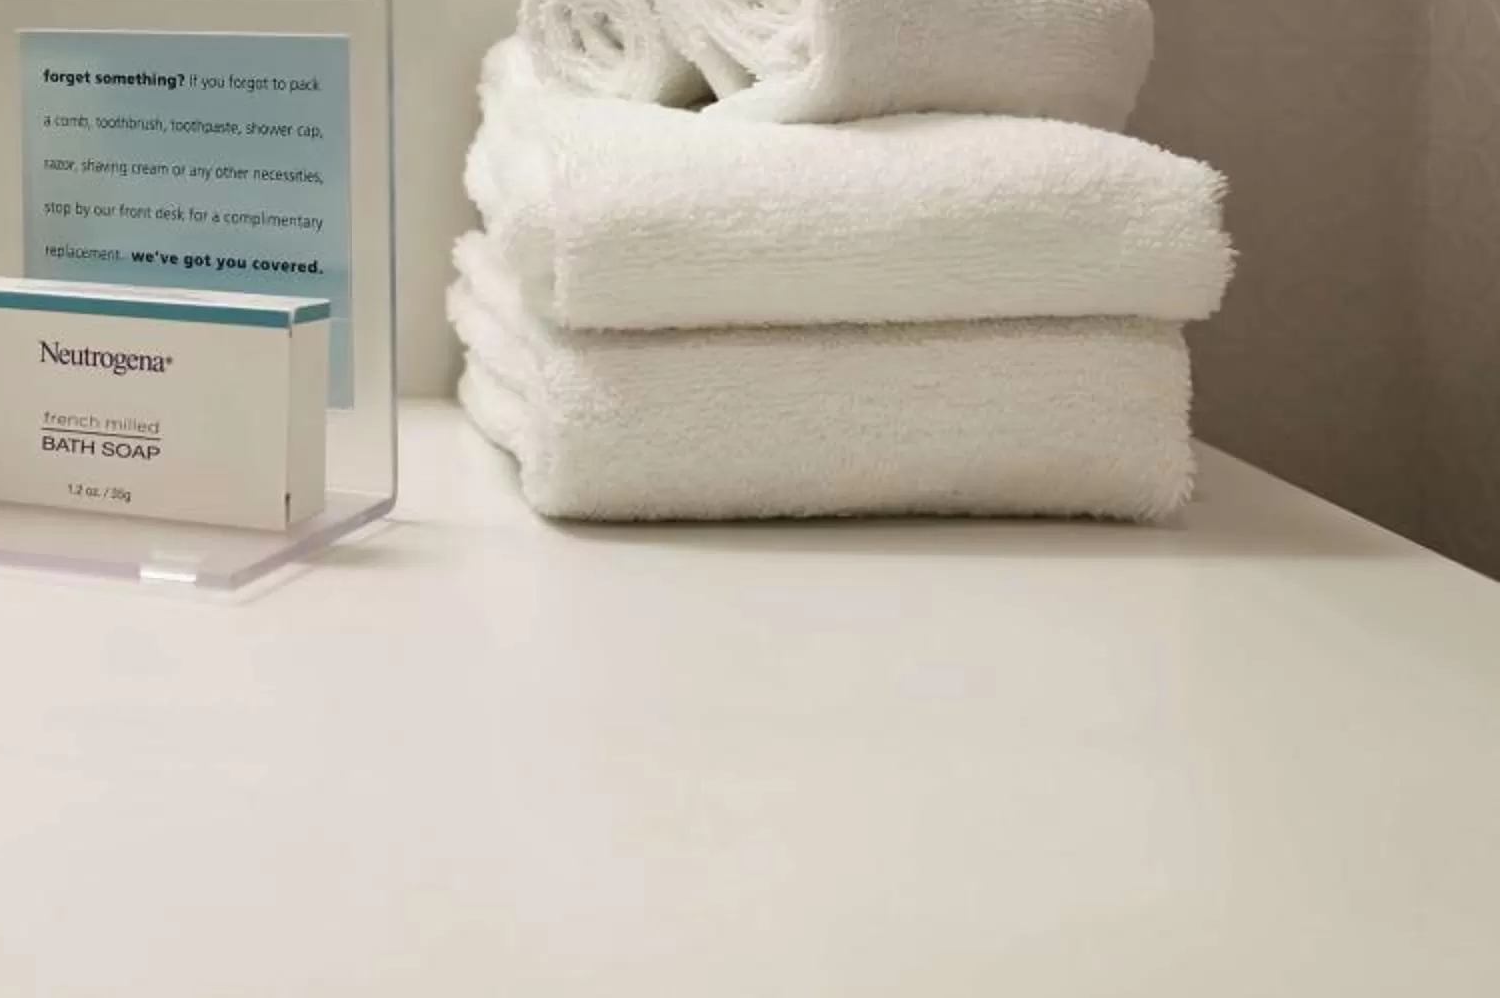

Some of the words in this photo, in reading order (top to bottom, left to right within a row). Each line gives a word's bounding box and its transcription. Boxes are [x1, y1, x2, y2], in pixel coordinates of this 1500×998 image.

[43, 68, 90, 87] forget
[95, 71, 186, 90] something?
[201, 76, 225, 91] you
[229, 73, 269, 94] forgot
[273, 76, 287, 90] to
[289, 76, 321, 94] pack
[43, 115, 51, 127] a
[95, 115, 167, 133] toothbrush,
[245, 122, 293, 137] shower
[297, 124, 323, 140] cap,
[81, 158, 129, 177] shaving
[131, 162, 169, 176] cream
[171, 164, 186, 177] or
[189, 166, 212, 182] any
[215, 164, 249, 180] other
[253, 168, 324, 186] necessities,
[43, 201, 71, 218] stop
[75, 201, 90, 219] by
[93, 204, 117, 217] our
[119, 203, 151, 219] front
[189, 207, 208, 222] for
[211, 212, 221, 223] a
[223, 210, 323, 232] complimentary
[131, 250, 179, 265] we've
[183, 254, 212, 270] got
[216, 257, 247, 271] you
[251, 259, 324, 275] covered.
[43, 411, 100, 428] french
[104, 417, 160, 435] milled
[41, 435, 95, 455] BATH
[101, 441, 161, 461] SOAP
